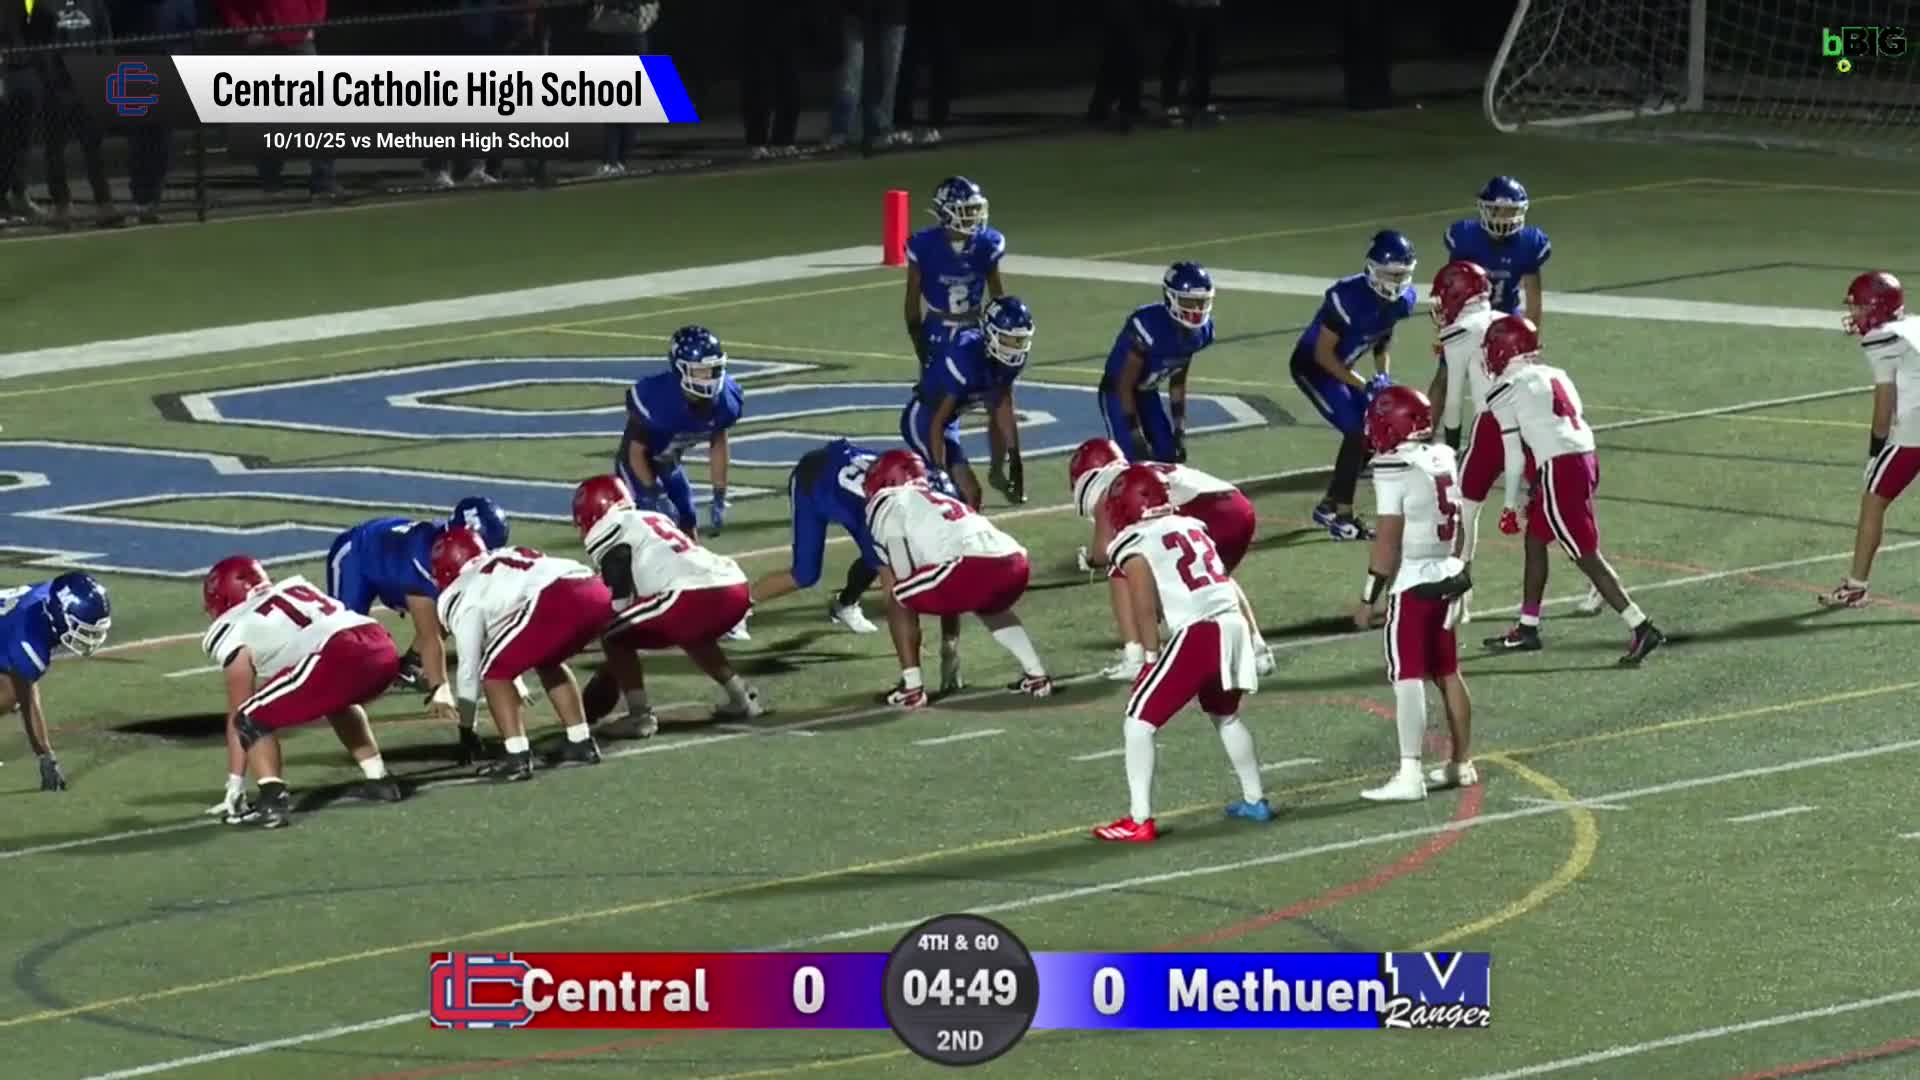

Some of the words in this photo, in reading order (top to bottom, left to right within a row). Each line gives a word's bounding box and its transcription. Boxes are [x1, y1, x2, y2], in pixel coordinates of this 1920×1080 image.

[1551, 376, 1581, 431] 4
[1161, 529, 1230, 592] 22
[254, 585, 338, 629] 79
